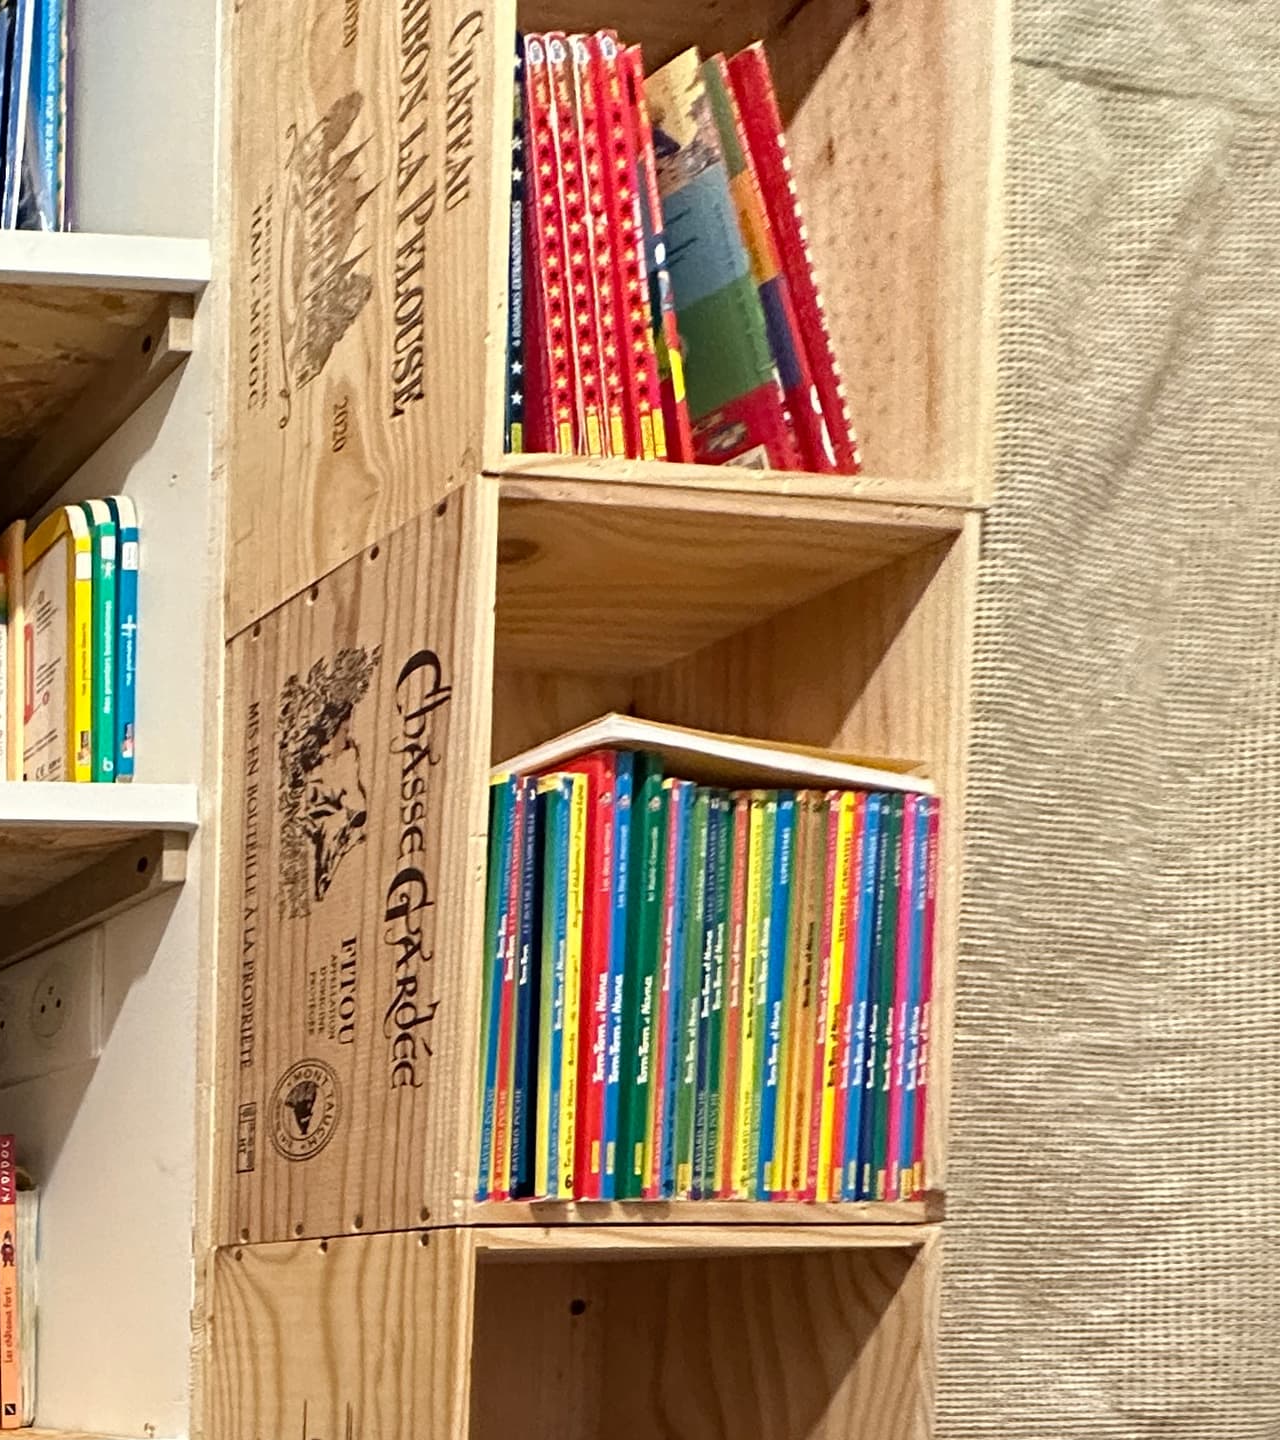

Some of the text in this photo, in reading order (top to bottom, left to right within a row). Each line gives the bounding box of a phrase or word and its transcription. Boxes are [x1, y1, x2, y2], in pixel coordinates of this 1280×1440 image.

[391, 181, 438, 421] PELOUSE
[512, 293, 522, 338] ROMANS
[331, 397, 350, 453] 2020
[242, 701, 261, 955] MIS EN BOUTEILLE LA
[336, 938, 359, 1046] FITOU
[595, 972, 609, 1012] Nana
[611, 974, 624, 1014] Nana
[640, 975, 653, 1014] Nana
